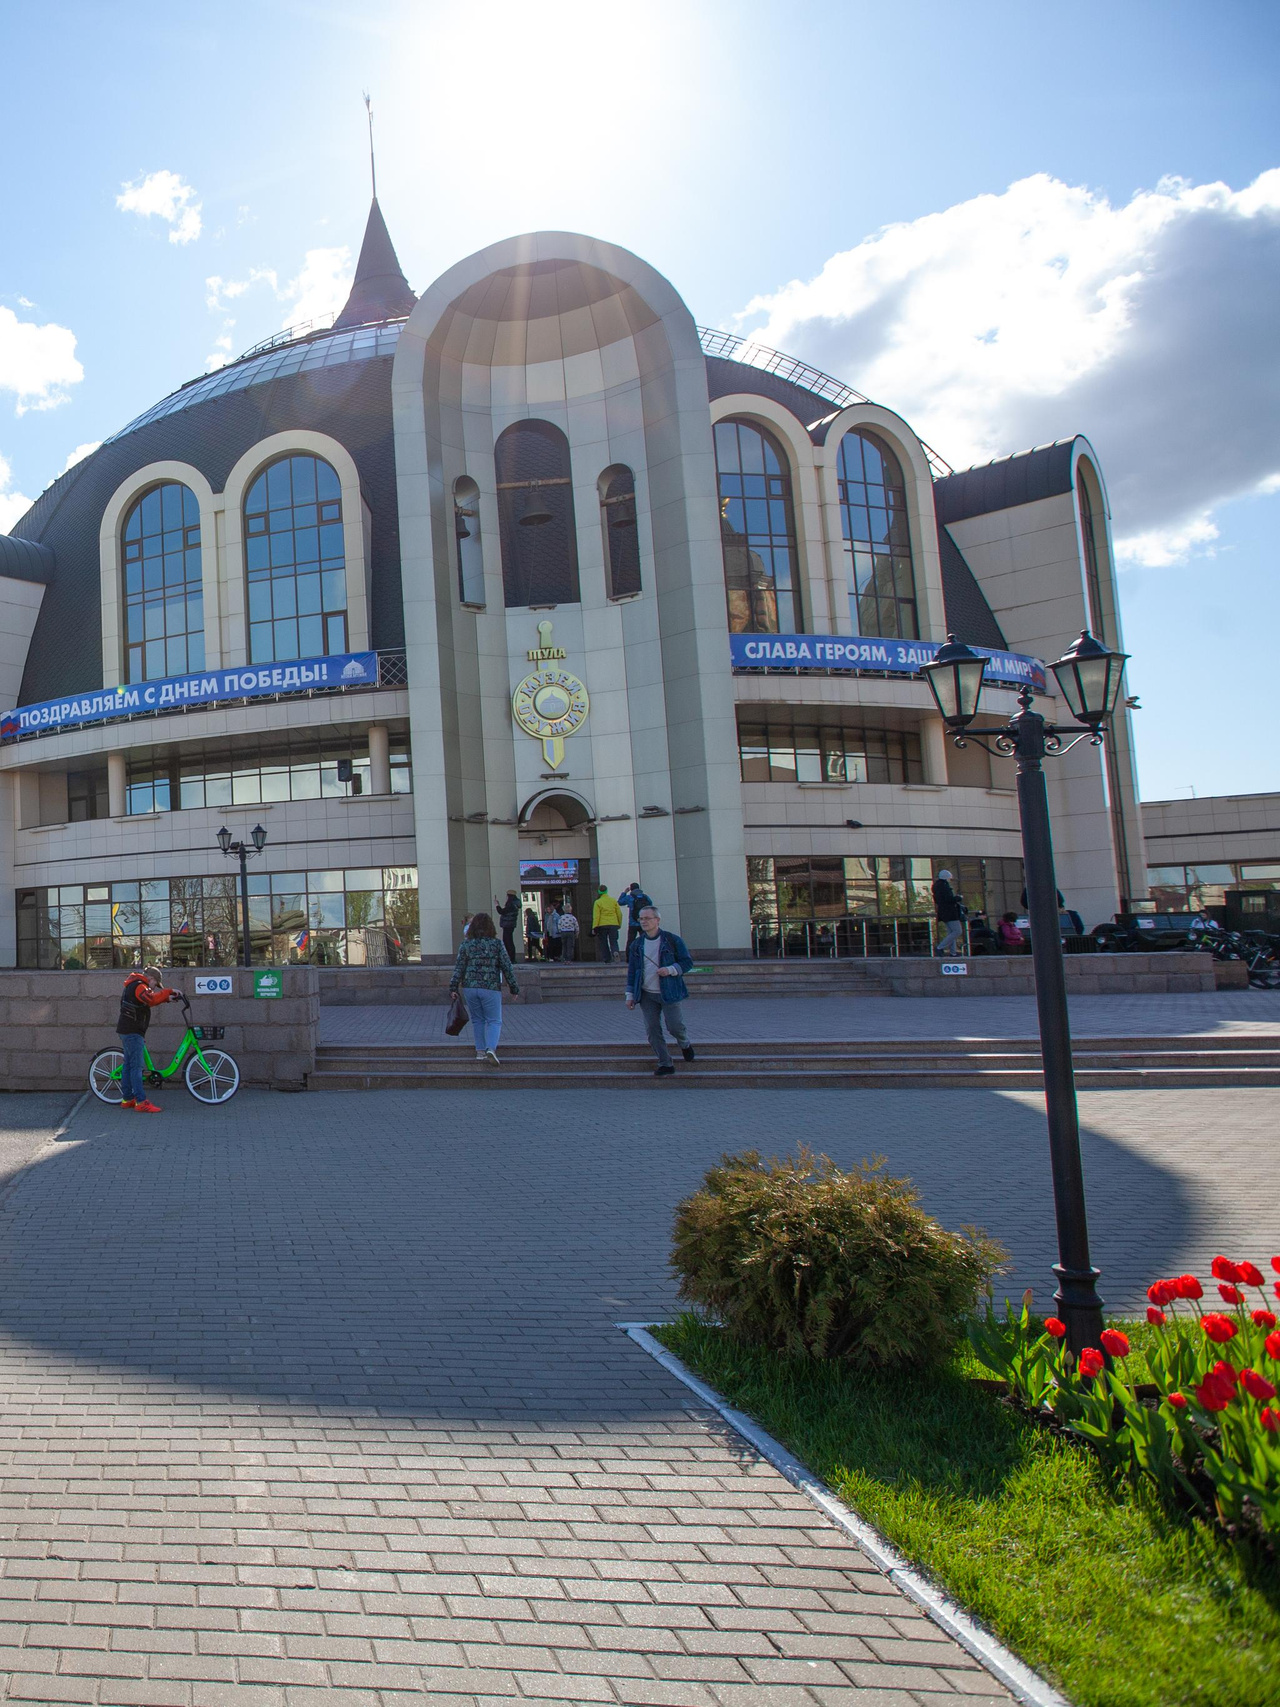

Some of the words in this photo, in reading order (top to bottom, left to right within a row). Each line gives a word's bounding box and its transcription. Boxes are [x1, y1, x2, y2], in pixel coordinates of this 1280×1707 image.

[527, 647, 567, 661] ТУЛА
[744, 641, 812, 660] СЛАВА
[815, 642, 892, 665] ГЕРОЯМ,
[1004, 658, 1033, 678] МИР!
[19, 690, 140, 728] ПОЗДРАВЛЯЕМ
[144, 687, 156, 704] С
[159, 677, 219, 704] ДНЕМ
[224, 663, 328, 692] ПОБЕДЫ!
[519, 701, 585, 735] ОРУЖИЯ
